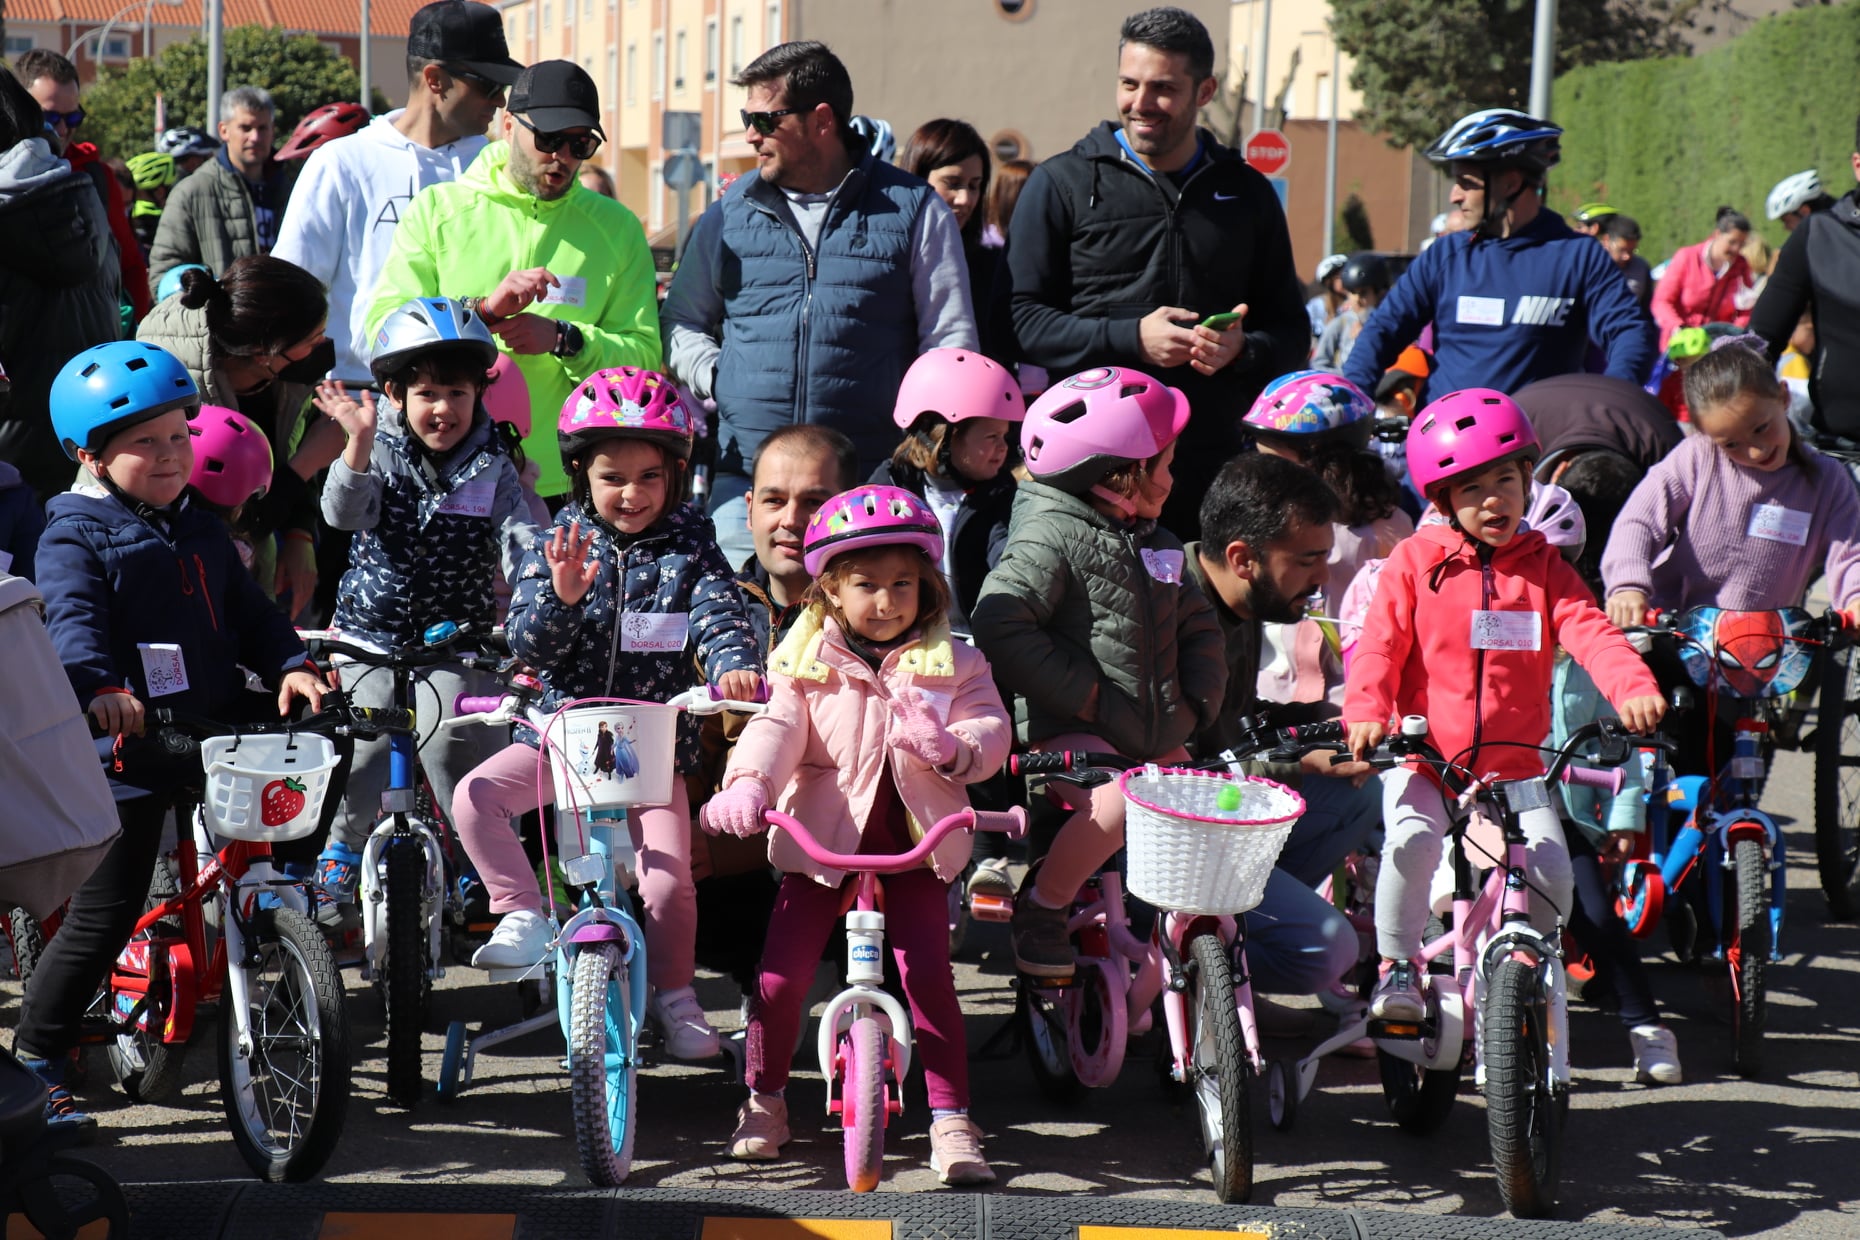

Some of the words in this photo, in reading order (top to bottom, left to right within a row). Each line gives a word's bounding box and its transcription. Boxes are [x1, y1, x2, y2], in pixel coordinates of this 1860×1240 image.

[1250, 146, 1286, 159] STOP
[1511, 296, 1576, 326] NIKE
[1275, 408, 1318, 429] Minnie
[631, 640, 665, 649] DORSAL
[667, 640, 682, 648] 020
[1480, 639, 1514, 647] DORSAL
[170, 652, 184, 686] DORSAL
[853, 946, 879, 959] chicco
